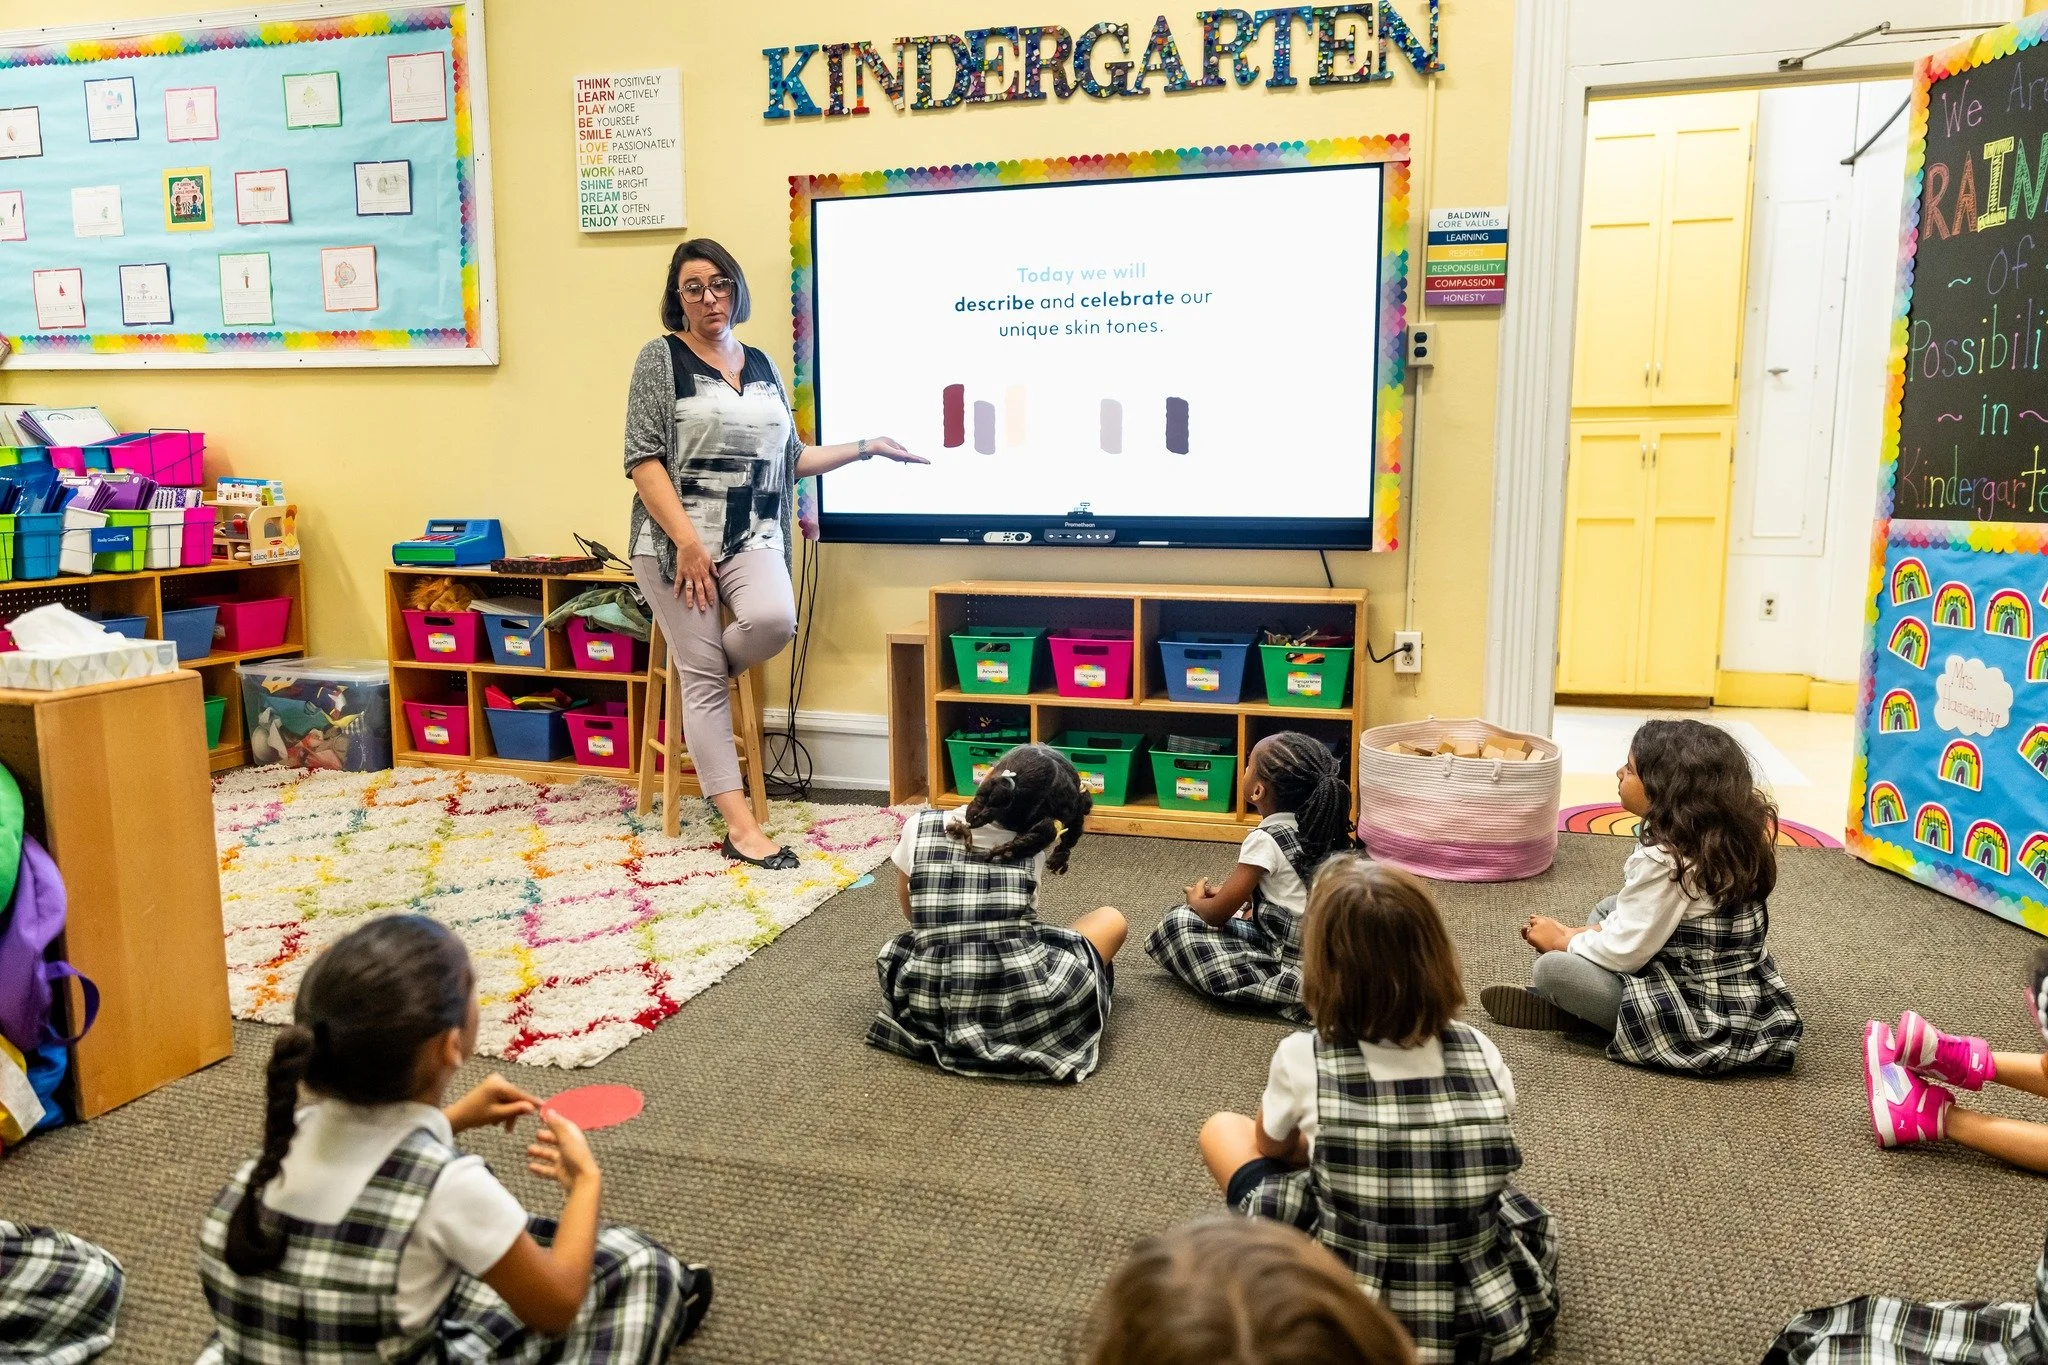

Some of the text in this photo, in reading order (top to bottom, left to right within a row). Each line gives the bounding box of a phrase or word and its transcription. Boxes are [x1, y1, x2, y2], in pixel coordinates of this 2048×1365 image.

[762, 0, 1445, 119] KINDERGARTEN
[577, 75, 661, 90] THINK POSITIVELY
[577, 89, 659, 103] LEARN ACTIVELY
[578, 103, 635, 115] PLAY MORE
[1942, 79, 1983, 138] We
[578, 116, 640, 128] BE YOURSELF
[579, 127, 652, 140] SMILE ALWAYS
[580, 139, 676, 153] LOVE PASSIONATELY
[580, 154, 637, 165] LIVE FREELY
[581, 166, 644, 178] WORK HARD
[580, 178, 648, 190] SHINE BRIGHT
[1923, 132, 2048, 240] RAIN
[581, 191, 637, 203] DREAM BIG
[582, 203, 650, 215] RELAX OFTEN
[1447, 211, 1490, 219] BALDWIN
[582, 215, 665, 228] ENJOY YOURSELF
[1437, 219, 1499, 228] CORE VALUES
[1446, 233, 1489, 242] LEARNING
[1449, 249, 1484, 257] RESPECT
[1017, 262, 1146, 285] Today we will
[1432, 263, 1500, 273] RESPONSIBILITY
[1435, 279, 1495, 287] COMPASSION
[955, 290, 1213, 312] describe and celebrate our
[1443, 294, 1486, 302] HONESTY
[999, 319, 1164, 340] unique skin tones.
[1910, 298, 2048, 382] Possibili
[1980, 394, 2009, 435] in
[285, 549, 299, 557] stack
[1951, 662, 1976, 690] Mrs.
[1973, 826, 2006, 850] Stella
